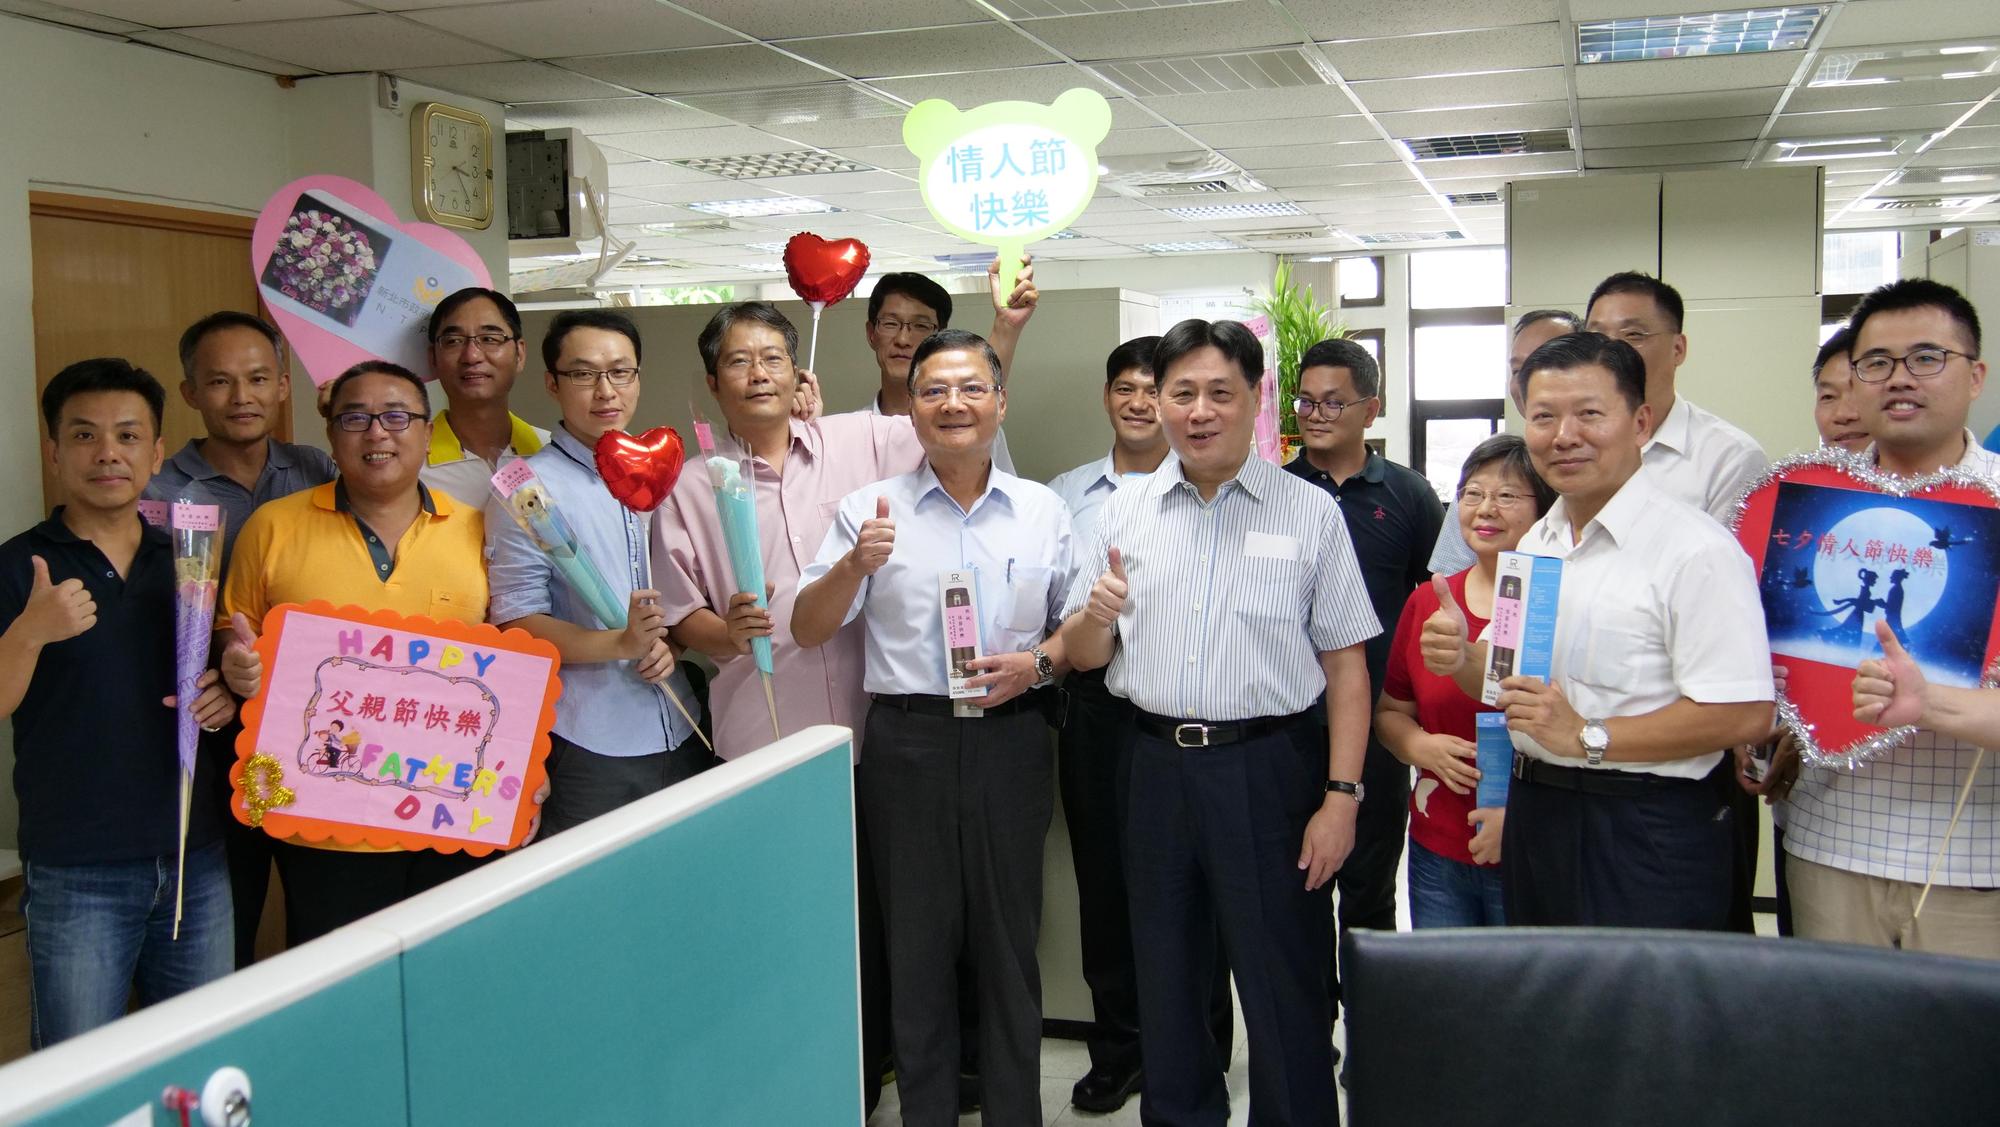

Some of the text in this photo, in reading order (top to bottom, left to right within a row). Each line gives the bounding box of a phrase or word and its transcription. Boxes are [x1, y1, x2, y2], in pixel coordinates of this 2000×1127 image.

[946, 137, 1066, 184] 情人節
[969, 189, 1050, 231] 快樂
[1772, 528, 1934, 568] 七夕情人節快樂
[338, 629, 496, 677] HAPPY
[326, 690, 482, 737] 父親節快樂
[362, 743, 522, 801] FATHER'S
[394, 794, 494, 834] DAY
